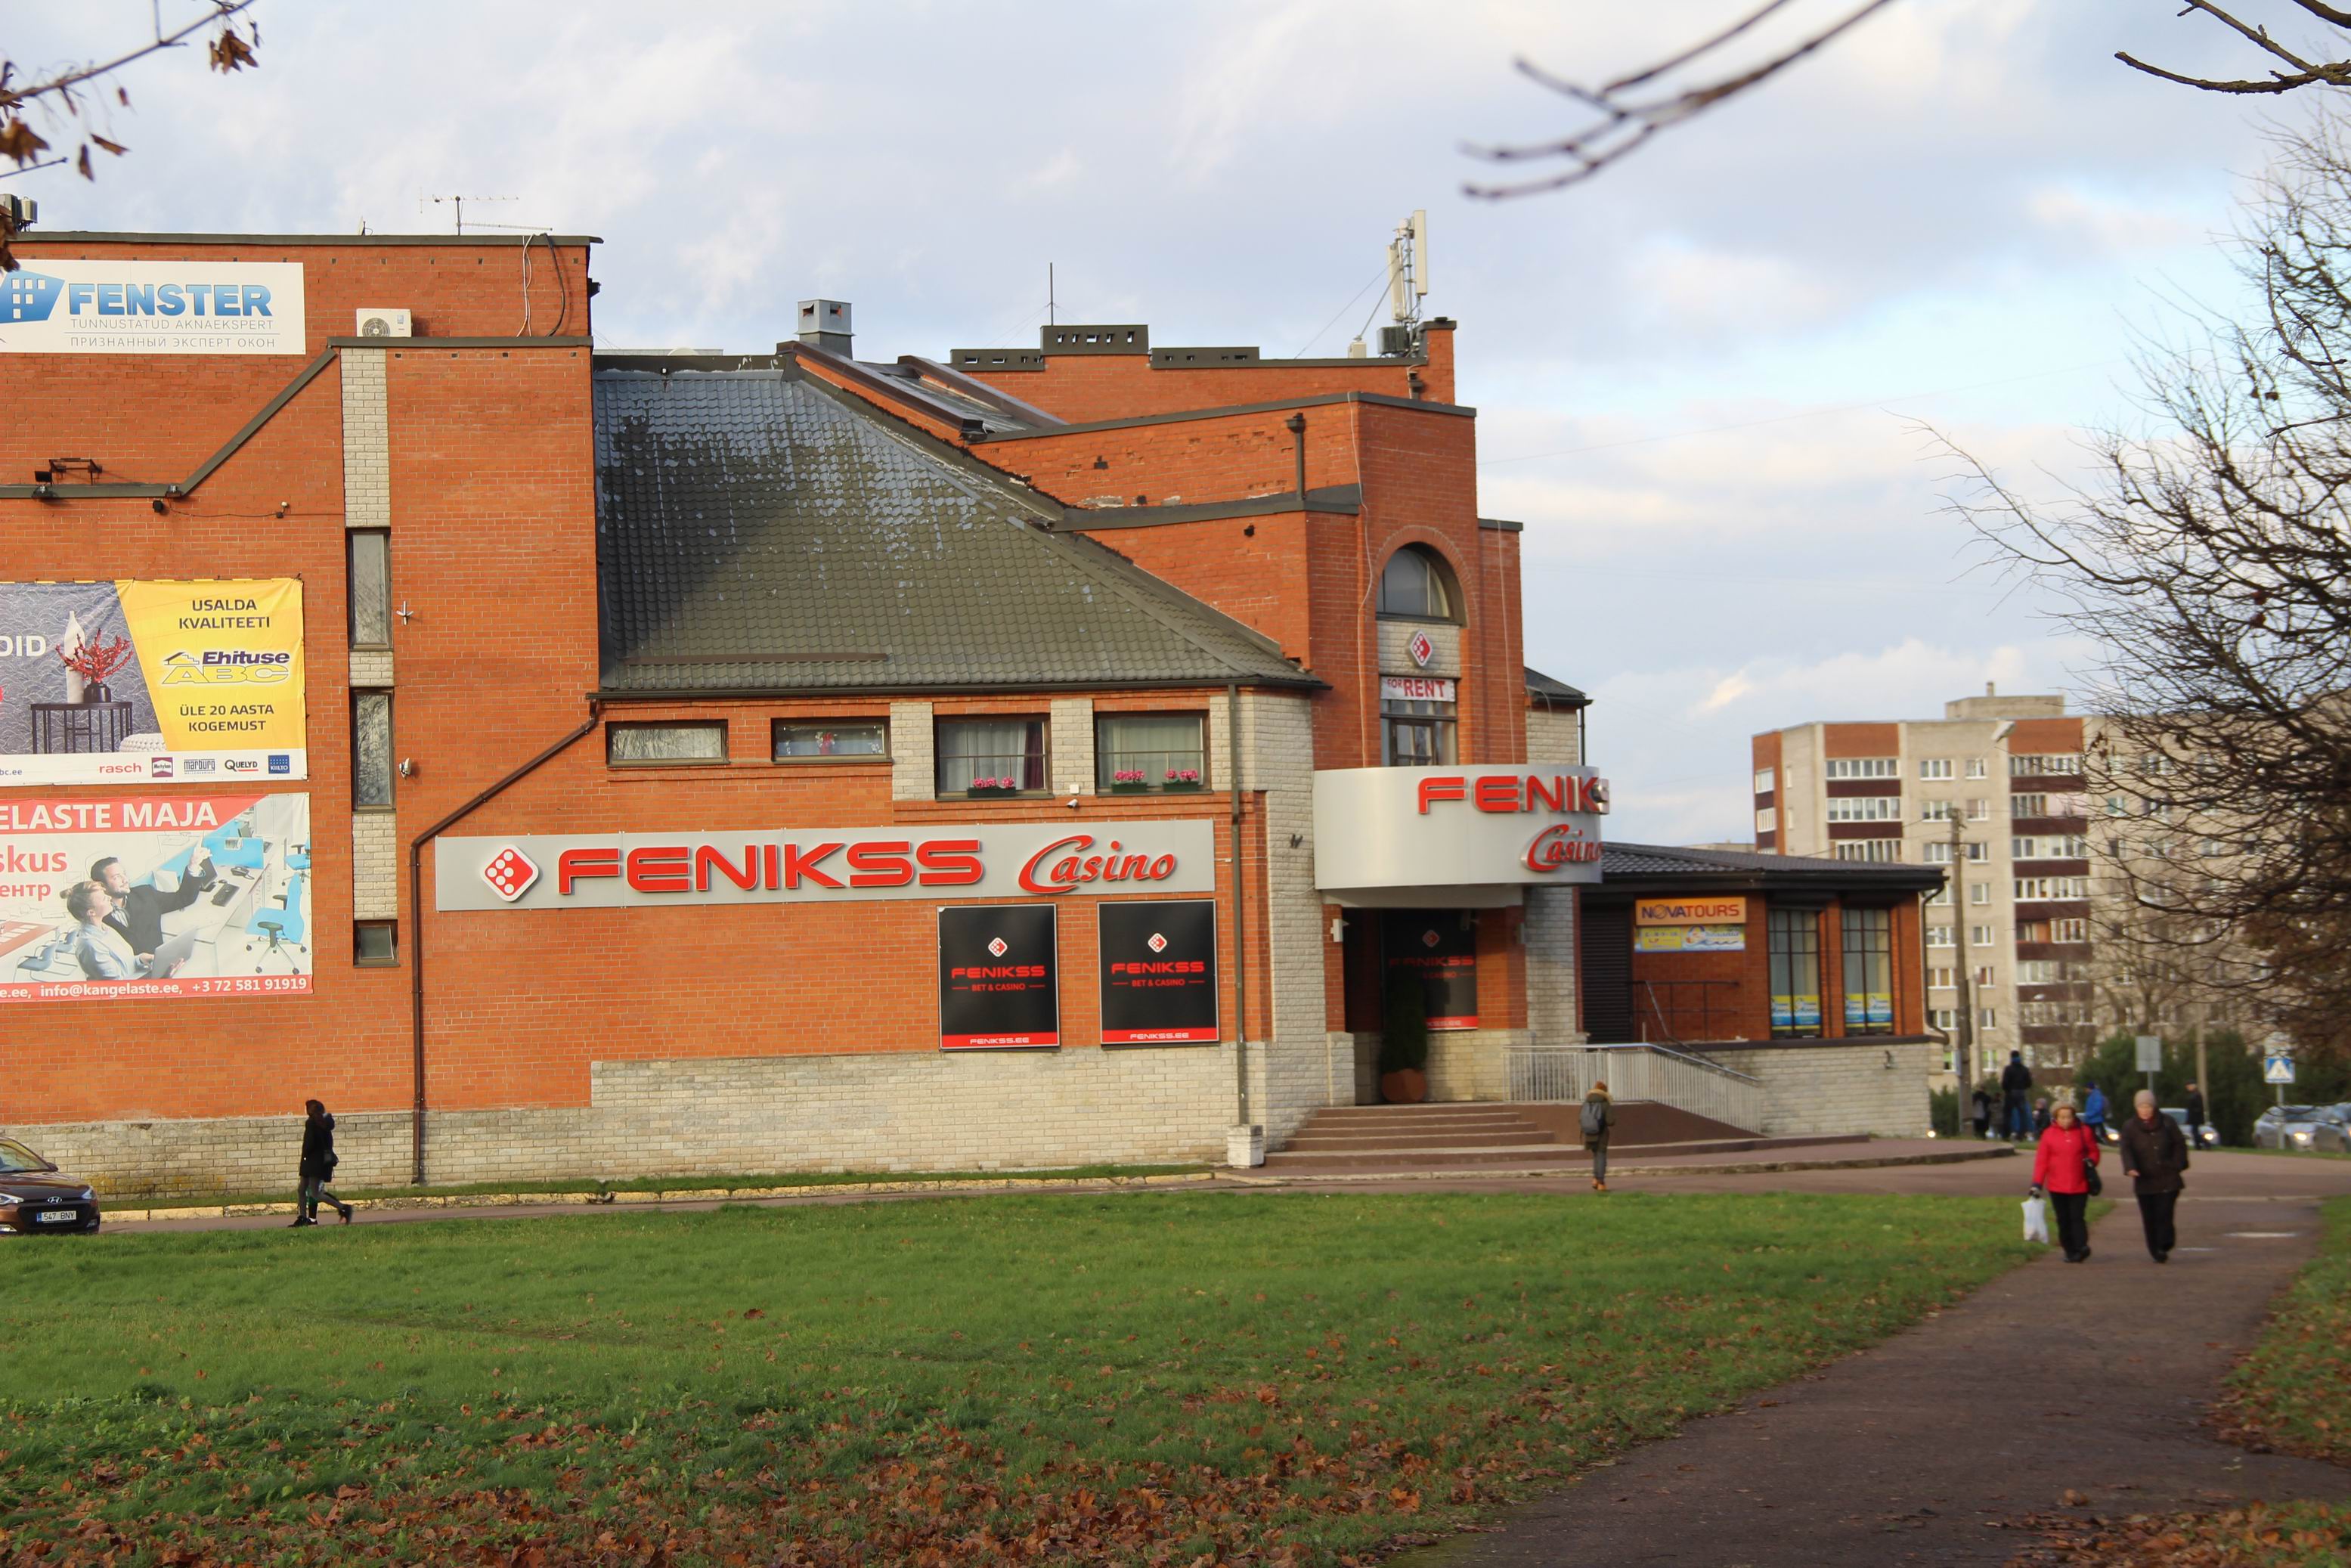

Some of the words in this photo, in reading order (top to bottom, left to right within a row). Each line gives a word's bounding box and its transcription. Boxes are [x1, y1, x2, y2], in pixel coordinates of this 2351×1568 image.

[69, 283, 272, 316] FENSTER
[70, 318, 170, 330] TUNNUSTATUD
[175, 319, 274, 331] AKNAEKSPERT
[70, 336, 166, 348] ПРИЗНАННЫЙ
[172, 337, 231, 348] ЭКСПЕРТ
[237, 338, 275, 348] ОКОН
[192, 599, 257, 612] USALDA
[178, 616, 271, 630] KVALITEETI
[203, 651, 290, 665] Ehituse
[162, 664, 290, 684] ABC
[1386, 677, 1402, 688] FOR
[1403, 678, 1445, 697] RENT
[180, 704, 206, 717] ÜLE
[210, 705, 226, 716] 20
[230, 705, 274, 715] AASTA
[188, 720, 267, 733] KOGEMUST
[99, 763, 141, 773] rasch
[184, 759, 215, 770] marburg
[225, 759, 258, 772] QUELYD
[0, 804, 111, 830] ELASTE
[123, 802, 218, 828] MAJA
[558, 840, 983, 894] FENIKSS
[1018, 835, 1178, 894] Casino
[1641, 904, 1740, 920] NOVATOURS
[951, 965, 1046, 979] FENIKSS
[1111, 961, 1206, 975] FENIKSS
[40, 983, 183, 998] info@kangelaste.ee,
[236, 979, 261, 991] 581
[265, 978, 307, 990] 91919
[971, 984, 986, 992] BET
[995, 983, 1026, 991] CASINO
[1155, 978, 1185, 987] CASINO
[970, 1037, 1030, 1045] FENIKSS.EE
[1129, 1031, 1189, 1040] FENIKSS.EE
[60, 1211, 74, 1219] BNY
